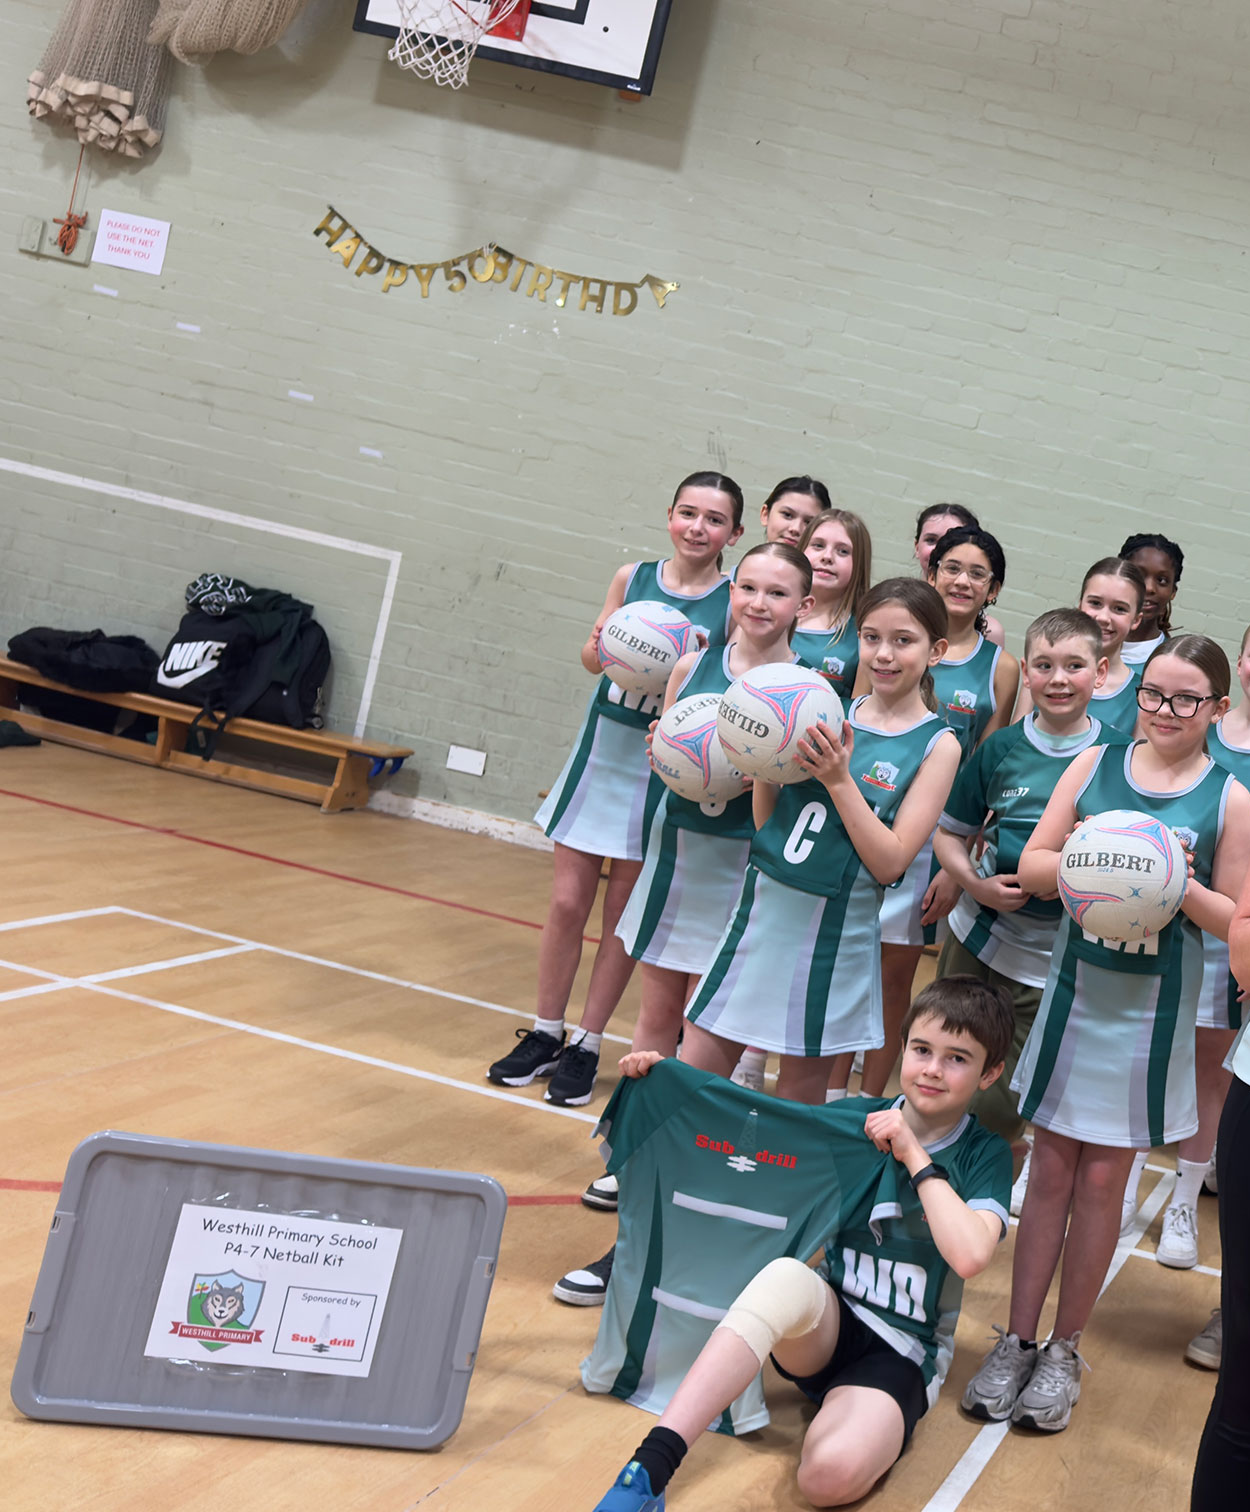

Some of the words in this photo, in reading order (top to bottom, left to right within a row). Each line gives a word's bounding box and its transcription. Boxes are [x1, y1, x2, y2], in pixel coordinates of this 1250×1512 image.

[107, 220, 129, 231] PLEASE
[131, 225, 143, 233] DO
[143, 227, 161, 237] NOT
[107, 232, 120, 240] USE
[123, 234, 137, 244] THE
[107, 244, 132, 256] THANK
[133, 250, 151, 260] YOU
[313, 205, 440, 298] HAPPY
[165, 640, 228, 672] NIKE
[608, 624, 671, 663] GILBERT
[718, 699, 770, 739] GILBE
[783, 801, 828, 865] C
[1066, 852, 1156, 873] GILBERT
[695, 1134, 735, 1155] Sub
[755, 1150, 798, 1169] drill
[202, 1218, 265, 1237] Westhill
[267, 1226, 325, 1247] Primary
[328, 1233, 378, 1250] School
[224, 1242, 260, 1259] P4-7
[263, 1247, 319, 1265] Netball
[322, 1253, 345, 1268] Kit
[841, 1247, 928, 1323] WD
[301, 1292, 348, 1306] Sponsored
[350, 1295, 362, 1308] by
[182, 1327, 218, 1339] WESTHILL
[218, 1331, 251, 1342] PRIMARY
[291, 1333, 317, 1344] Sub
[329, 1337, 355, 1348] drill
